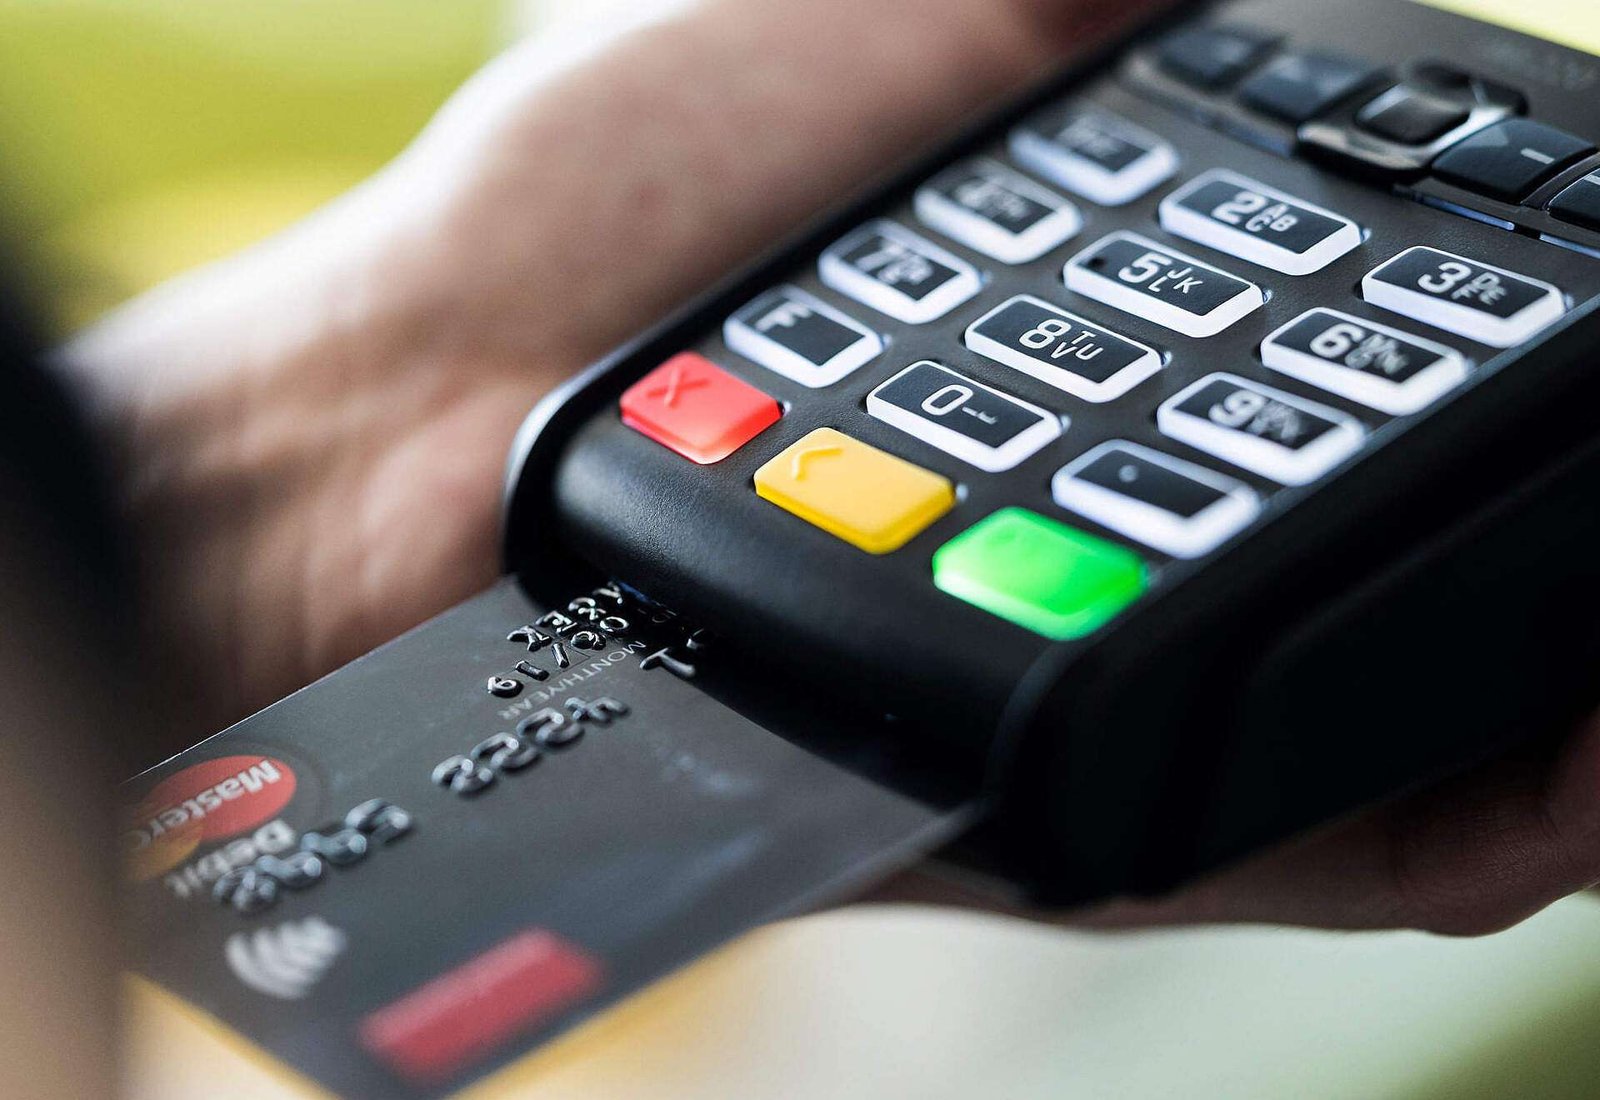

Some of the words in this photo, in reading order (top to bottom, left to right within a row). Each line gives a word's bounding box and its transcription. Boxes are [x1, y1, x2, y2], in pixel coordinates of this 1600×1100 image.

[1211, 191, 1268, 225] 2
[1118, 252, 1172, 283] 5
[1417, 262, 1472, 293] 3
[1019, 319, 1072, 349] 8
[1309, 323, 1366, 359] 6
[921, 384, 974, 416] 0
[1208, 389, 1267, 428] 9
[498, 640, 647, 721] MONTH/YEAR
